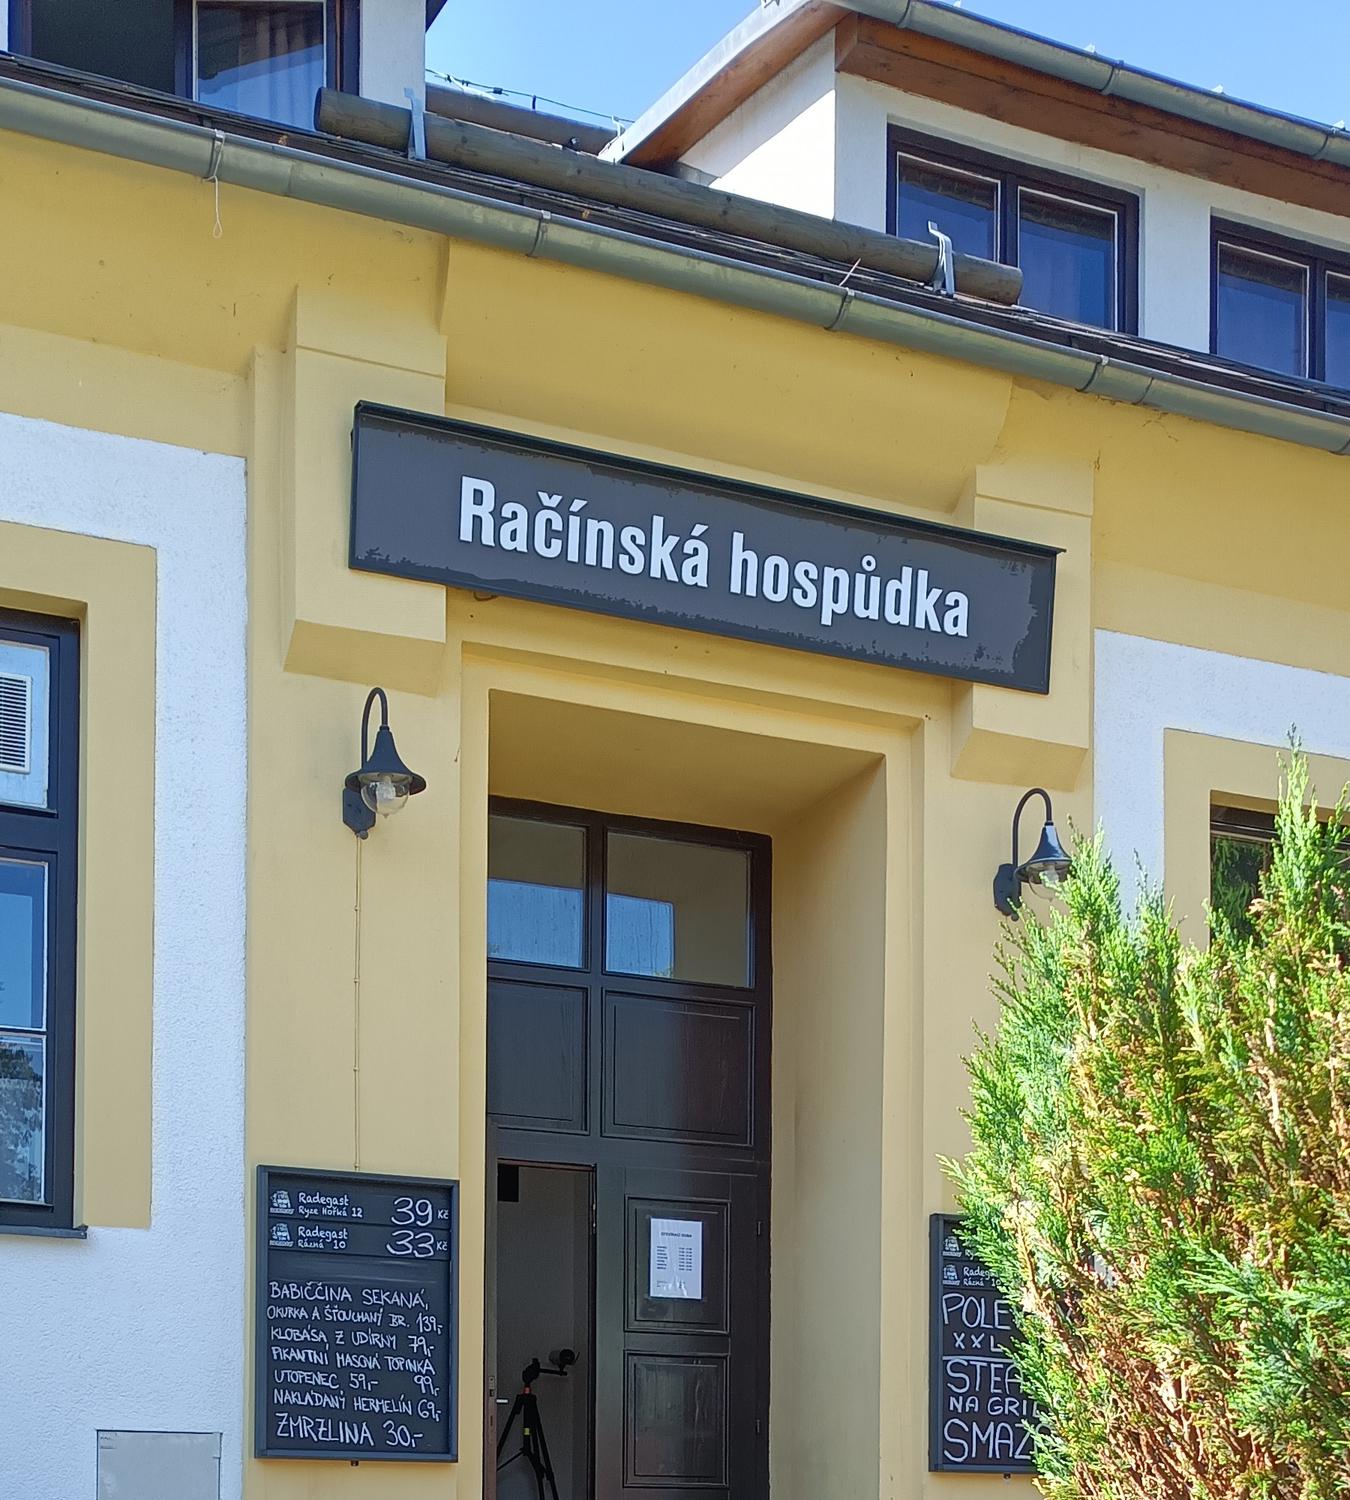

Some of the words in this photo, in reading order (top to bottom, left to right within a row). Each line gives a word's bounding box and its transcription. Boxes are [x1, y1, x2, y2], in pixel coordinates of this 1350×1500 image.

[458, 474, 710, 588] Račínská
[729, 530, 970, 638] hospůdka
[298, 1192, 350, 1208] Radegast
[298, 1205, 319, 1218] Ryze
[322, 1206, 348, 1217] Hořká
[351, 1207, 363, 1218] 12
[391, 1197, 433, 1226] 39
[437, 1209, 449, 1220] Kč
[297, 1238, 325, 1249] Rázná
[333, 1239, 347, 1249] 10
[298, 1225, 348, 1242] Radegast
[386, 1229, 434, 1258] 33
[436, 1240, 448, 1251] Kč
[269, 1281, 353, 1302] BABIČČINA
[266, 1305, 309, 1320] OKURKA
[311, 1306, 321, 1321] A
[388, 1313, 411, 1328] BR.
[334, 1330, 345, 1345] Z
[271, 1343, 330, 1366] PIKANTNÍ
[336, 1352, 381, 1370] MASOVÁ
[384, 1356, 436, 1375] TOPINKA
[274, 1369, 340, 1389] UTOPENEC
[353, 1394, 413, 1416] HERMELÍN
[949, 1396, 979, 1413] NA
[275, 1412, 375, 1446] ZMRZLINA
